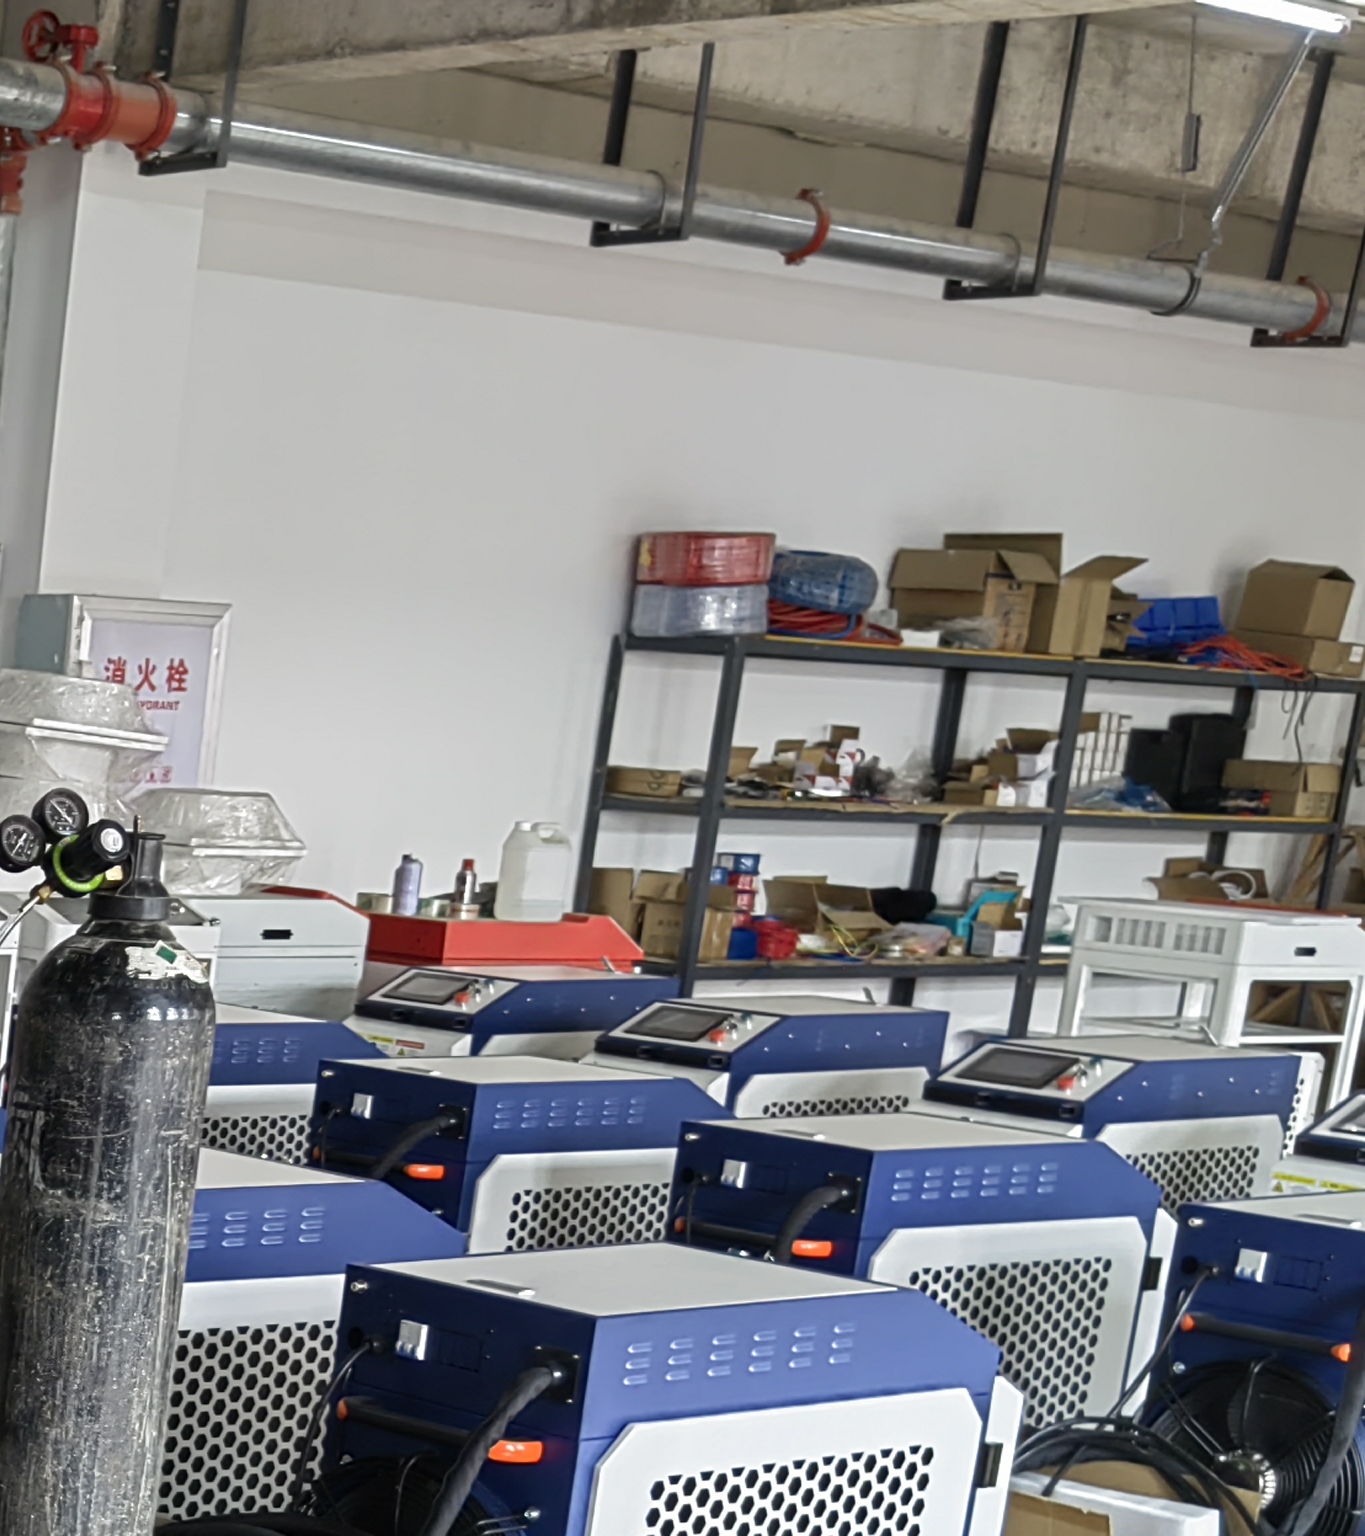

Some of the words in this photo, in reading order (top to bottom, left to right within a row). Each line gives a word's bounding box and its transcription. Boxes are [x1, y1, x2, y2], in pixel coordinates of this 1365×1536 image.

[104, 656, 189, 693] 消火栓
[138, 700, 181, 711] YDRANT
